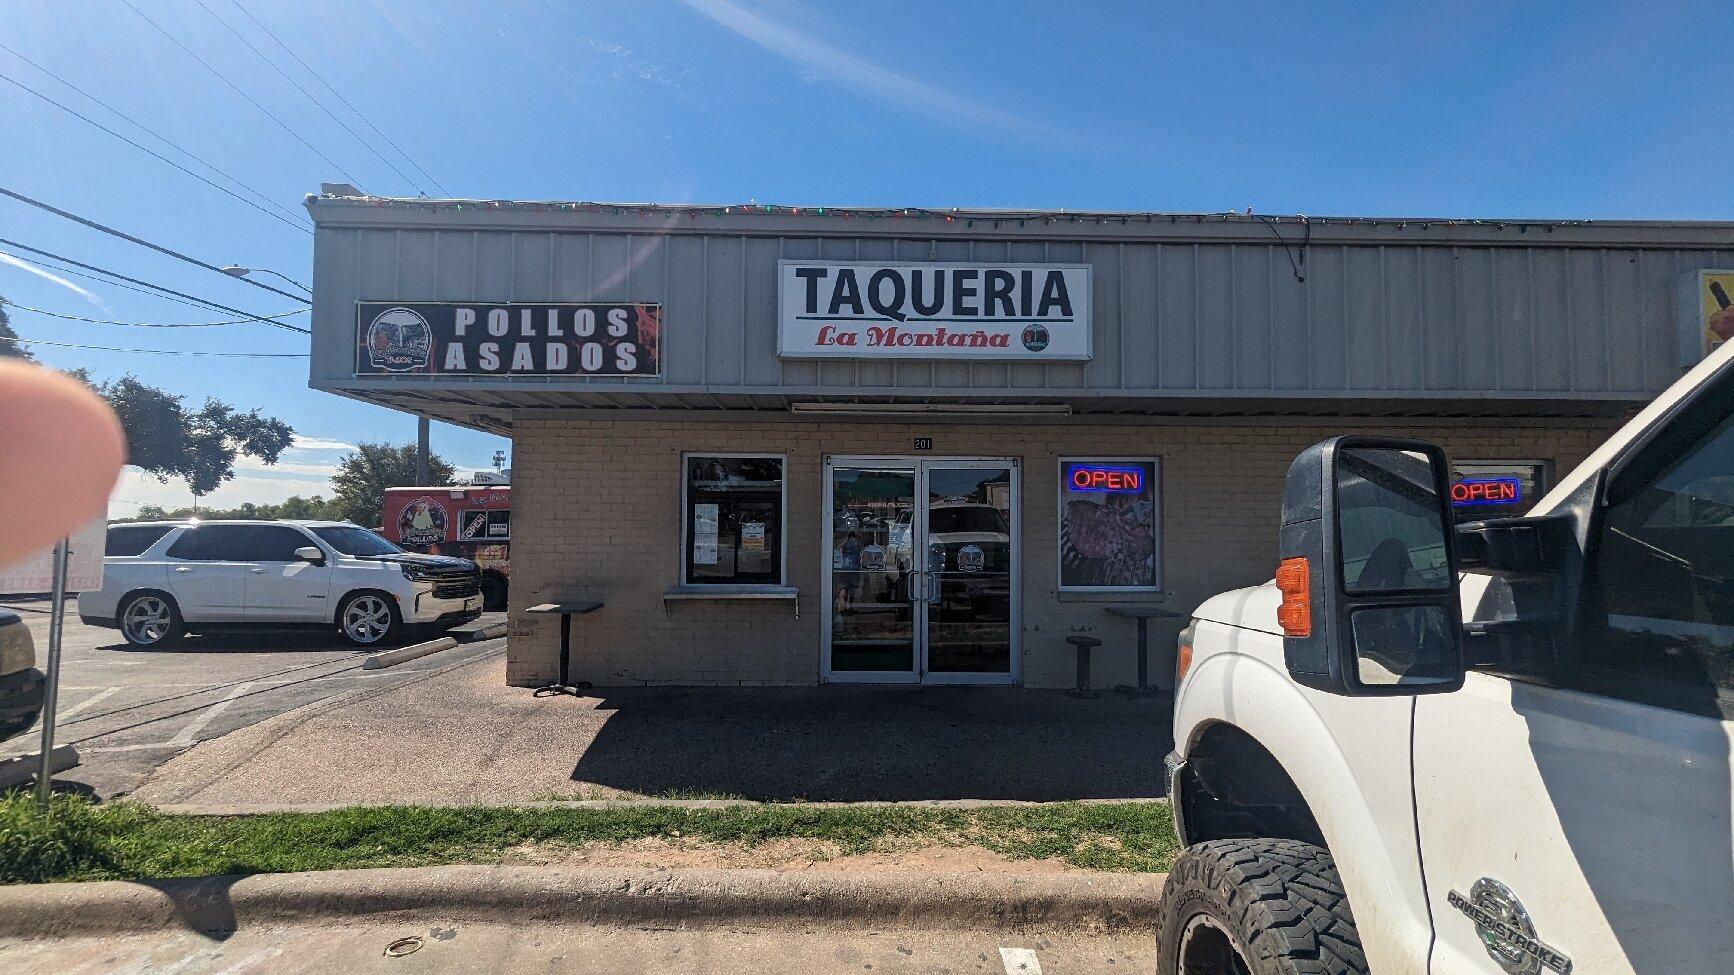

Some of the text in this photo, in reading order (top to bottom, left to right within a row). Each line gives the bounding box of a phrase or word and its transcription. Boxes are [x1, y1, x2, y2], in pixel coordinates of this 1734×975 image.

[796, 268, 1074, 321] TAQUERIA
[455, 308, 628, 337] POLLOS
[815, 326, 1010, 348] La Montaña
[444, 342, 637, 371] ASADOS
[915, 438, 930, 448] 201
[1074, 470, 1138, 488] OPEN
[1452, 483, 1515, 500] OPEN
